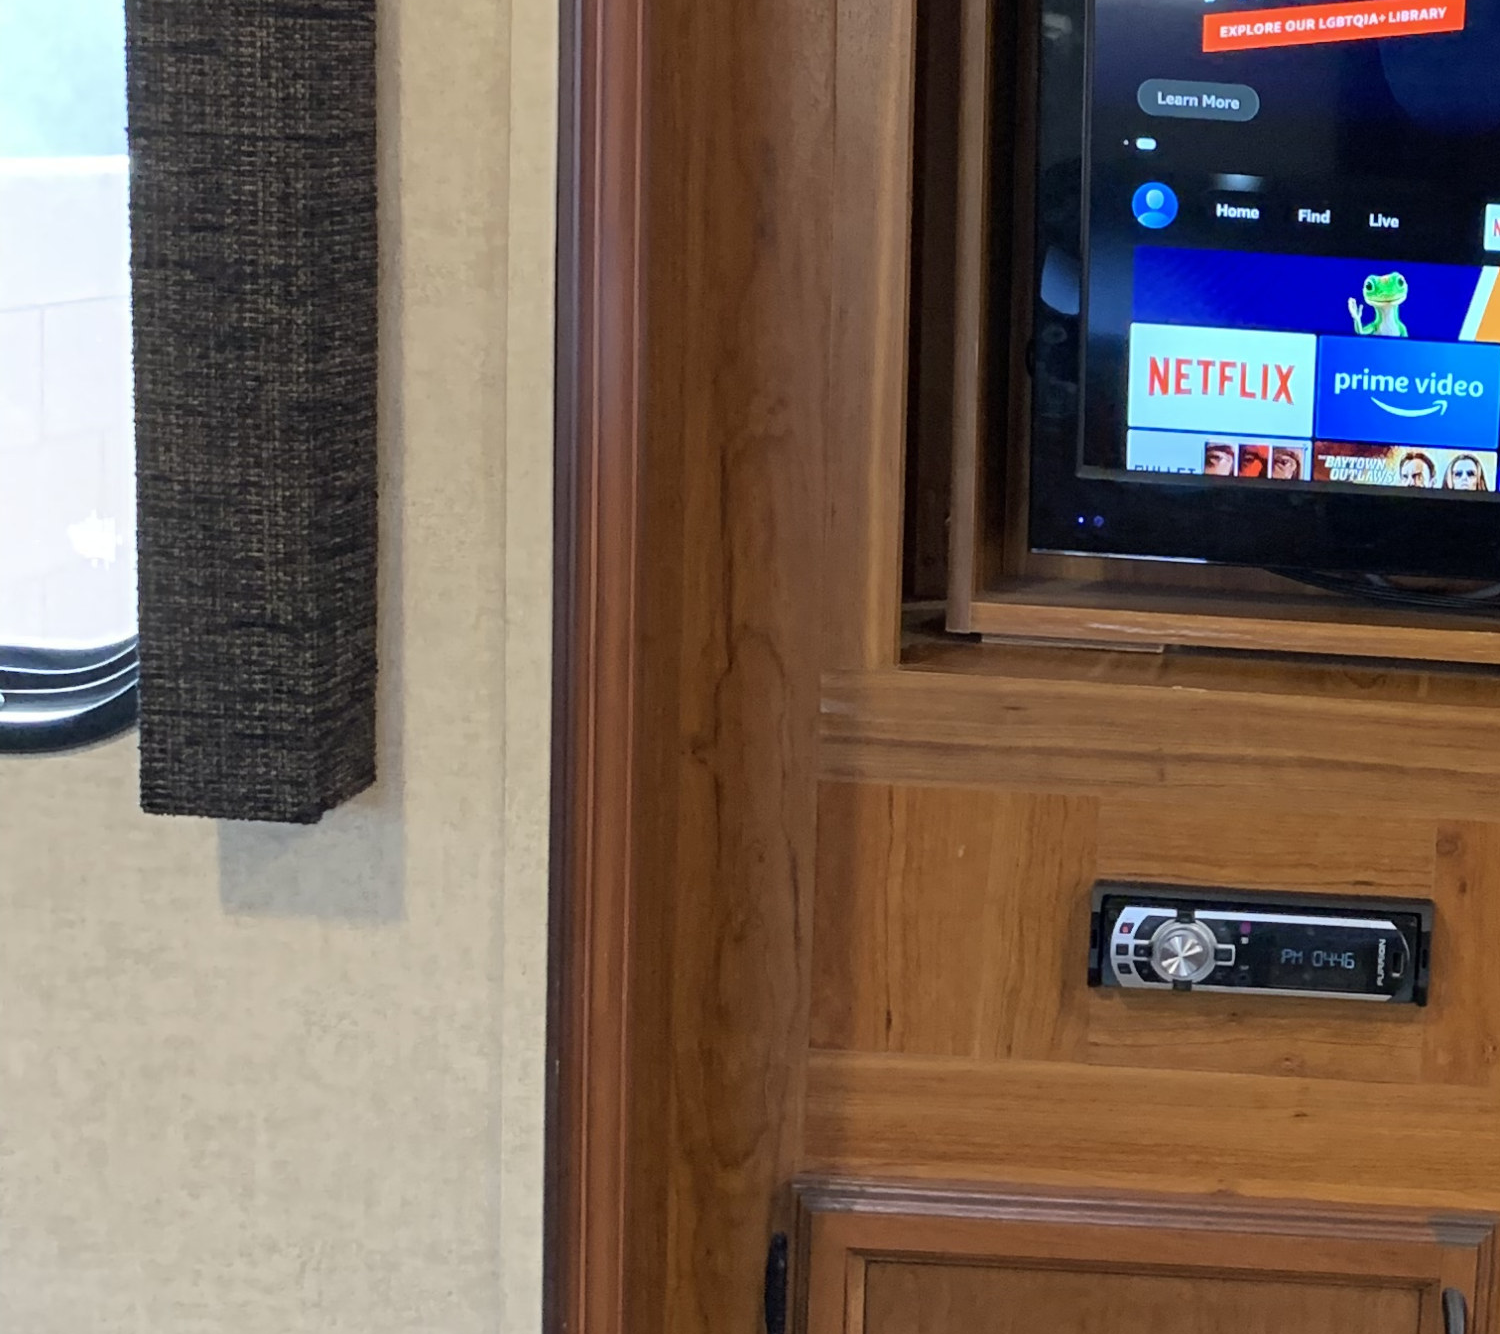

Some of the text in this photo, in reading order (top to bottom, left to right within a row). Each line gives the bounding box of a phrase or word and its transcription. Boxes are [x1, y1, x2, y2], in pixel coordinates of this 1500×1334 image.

[1219, 6, 1447, 38] EXPLORE OUR LGBTQIA+ LIBRARY
[1157, 91, 1240, 111] Learn More
[1216, 203, 1400, 229] Home Find Live
[1148, 357, 1295, 405] NETFLIX
[1334, 368, 1484, 398] prime video
[1325, 454, 1386, 468] BAYTOWN
[1329, 467, 1397, 484] OUTLAWS
